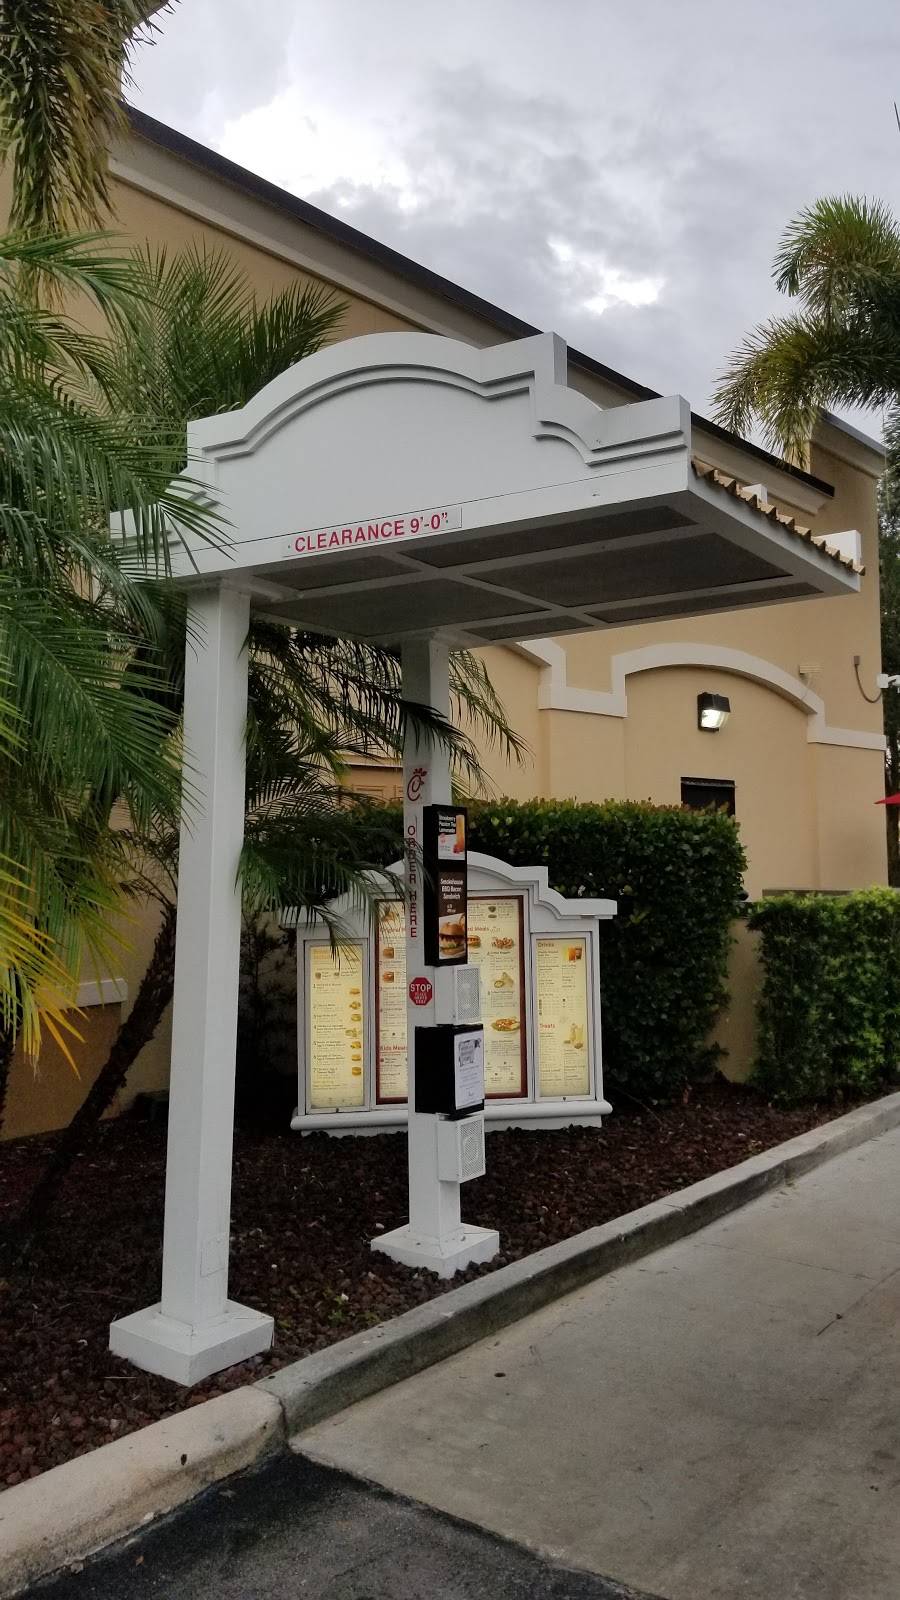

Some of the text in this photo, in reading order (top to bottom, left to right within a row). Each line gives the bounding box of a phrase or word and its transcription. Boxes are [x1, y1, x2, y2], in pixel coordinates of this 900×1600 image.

[294, 519, 405, 552] CLEARANCE
[407, 825, 417, 938] ORDER HERE
[410, 983, 432, 993] STOP
